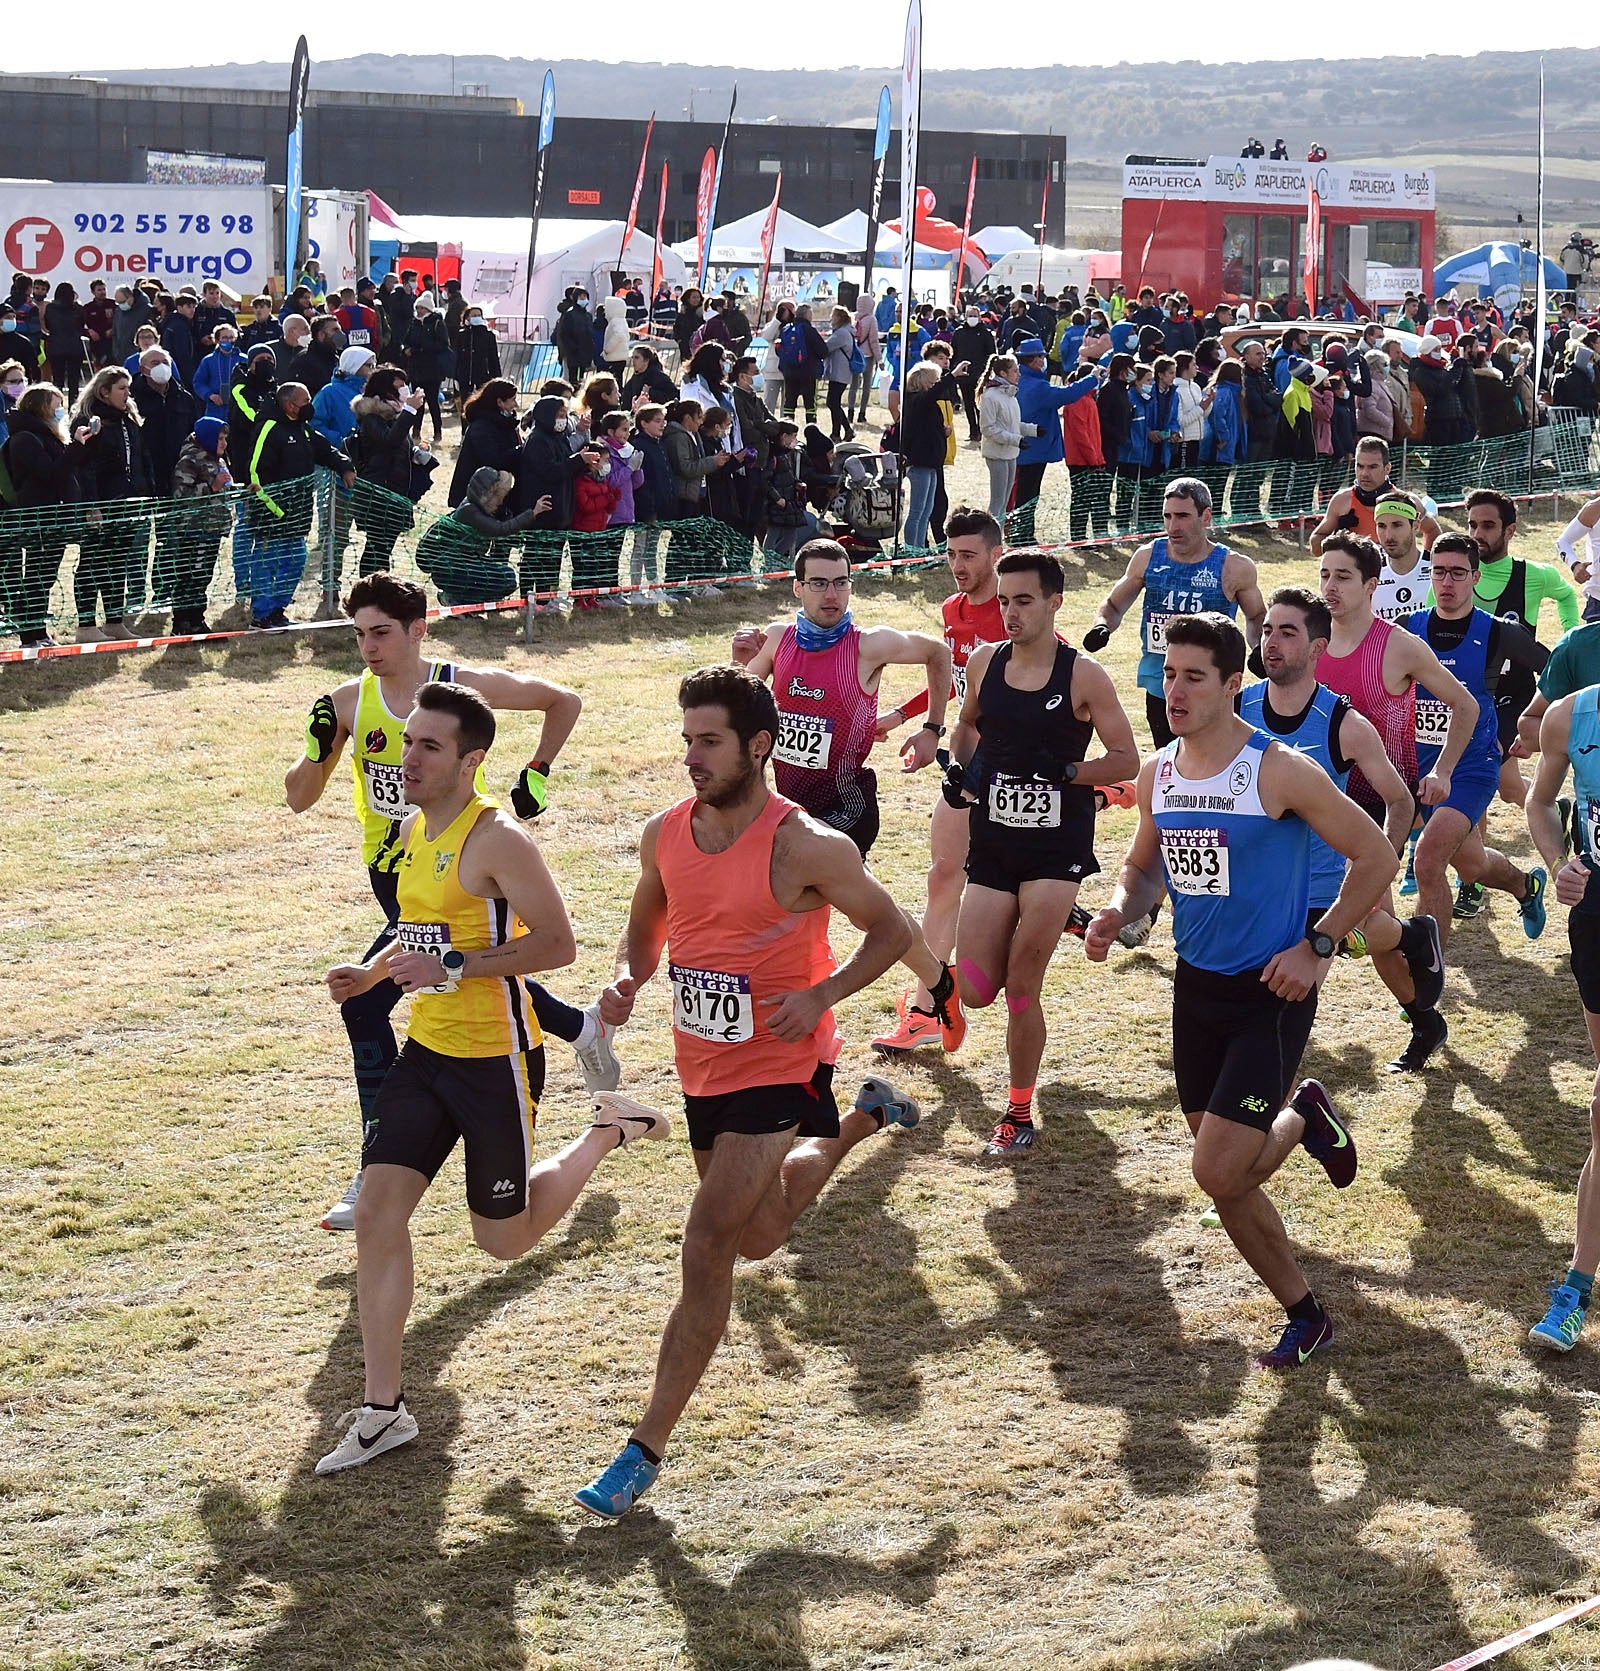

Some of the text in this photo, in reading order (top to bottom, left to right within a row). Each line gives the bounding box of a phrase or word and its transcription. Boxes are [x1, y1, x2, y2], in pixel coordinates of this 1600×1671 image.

[1128, 176, 1202, 188] ATAPUERCA
[1255, 174, 1306, 190] ATAPUERCA
[1348, 179, 1395, 194] ATAPUERCA
[1404, 172, 1430, 193] Burgos
[74, 213, 254, 235] 902 55 78 98
[74, 245, 252, 281] OneFurgO
[1162, 590, 1203, 612] 475
[778, 711, 827, 725] IPUTACIÓN
[778, 718, 826, 732] URGOS
[1415, 711, 1450, 732] 652
[777, 726, 822, 755] 6202
[367, 761, 402, 775] DIPUTA
[369, 768, 399, 781] BUR
[373, 779, 402, 806] 63
[995, 788, 1052, 815] 6123
[1198, 795, 1207, 809] DE
[1208, 796, 1236, 811] BURGOS
[1161, 827, 1218, 838] DIPUTACIÓN
[1162, 837, 1220, 847] BURGOS
[1167, 848, 1220, 876] 6583
[398, 923, 442, 935] IPUTACIÓN
[401, 932, 443, 943] URGOS
[673, 966, 739, 985] DIPUTACIÓN
[676, 974, 740, 994] BURGOS
[680, 985, 740, 1023] 6170
[680, 1017, 714, 1037] iberCaja
